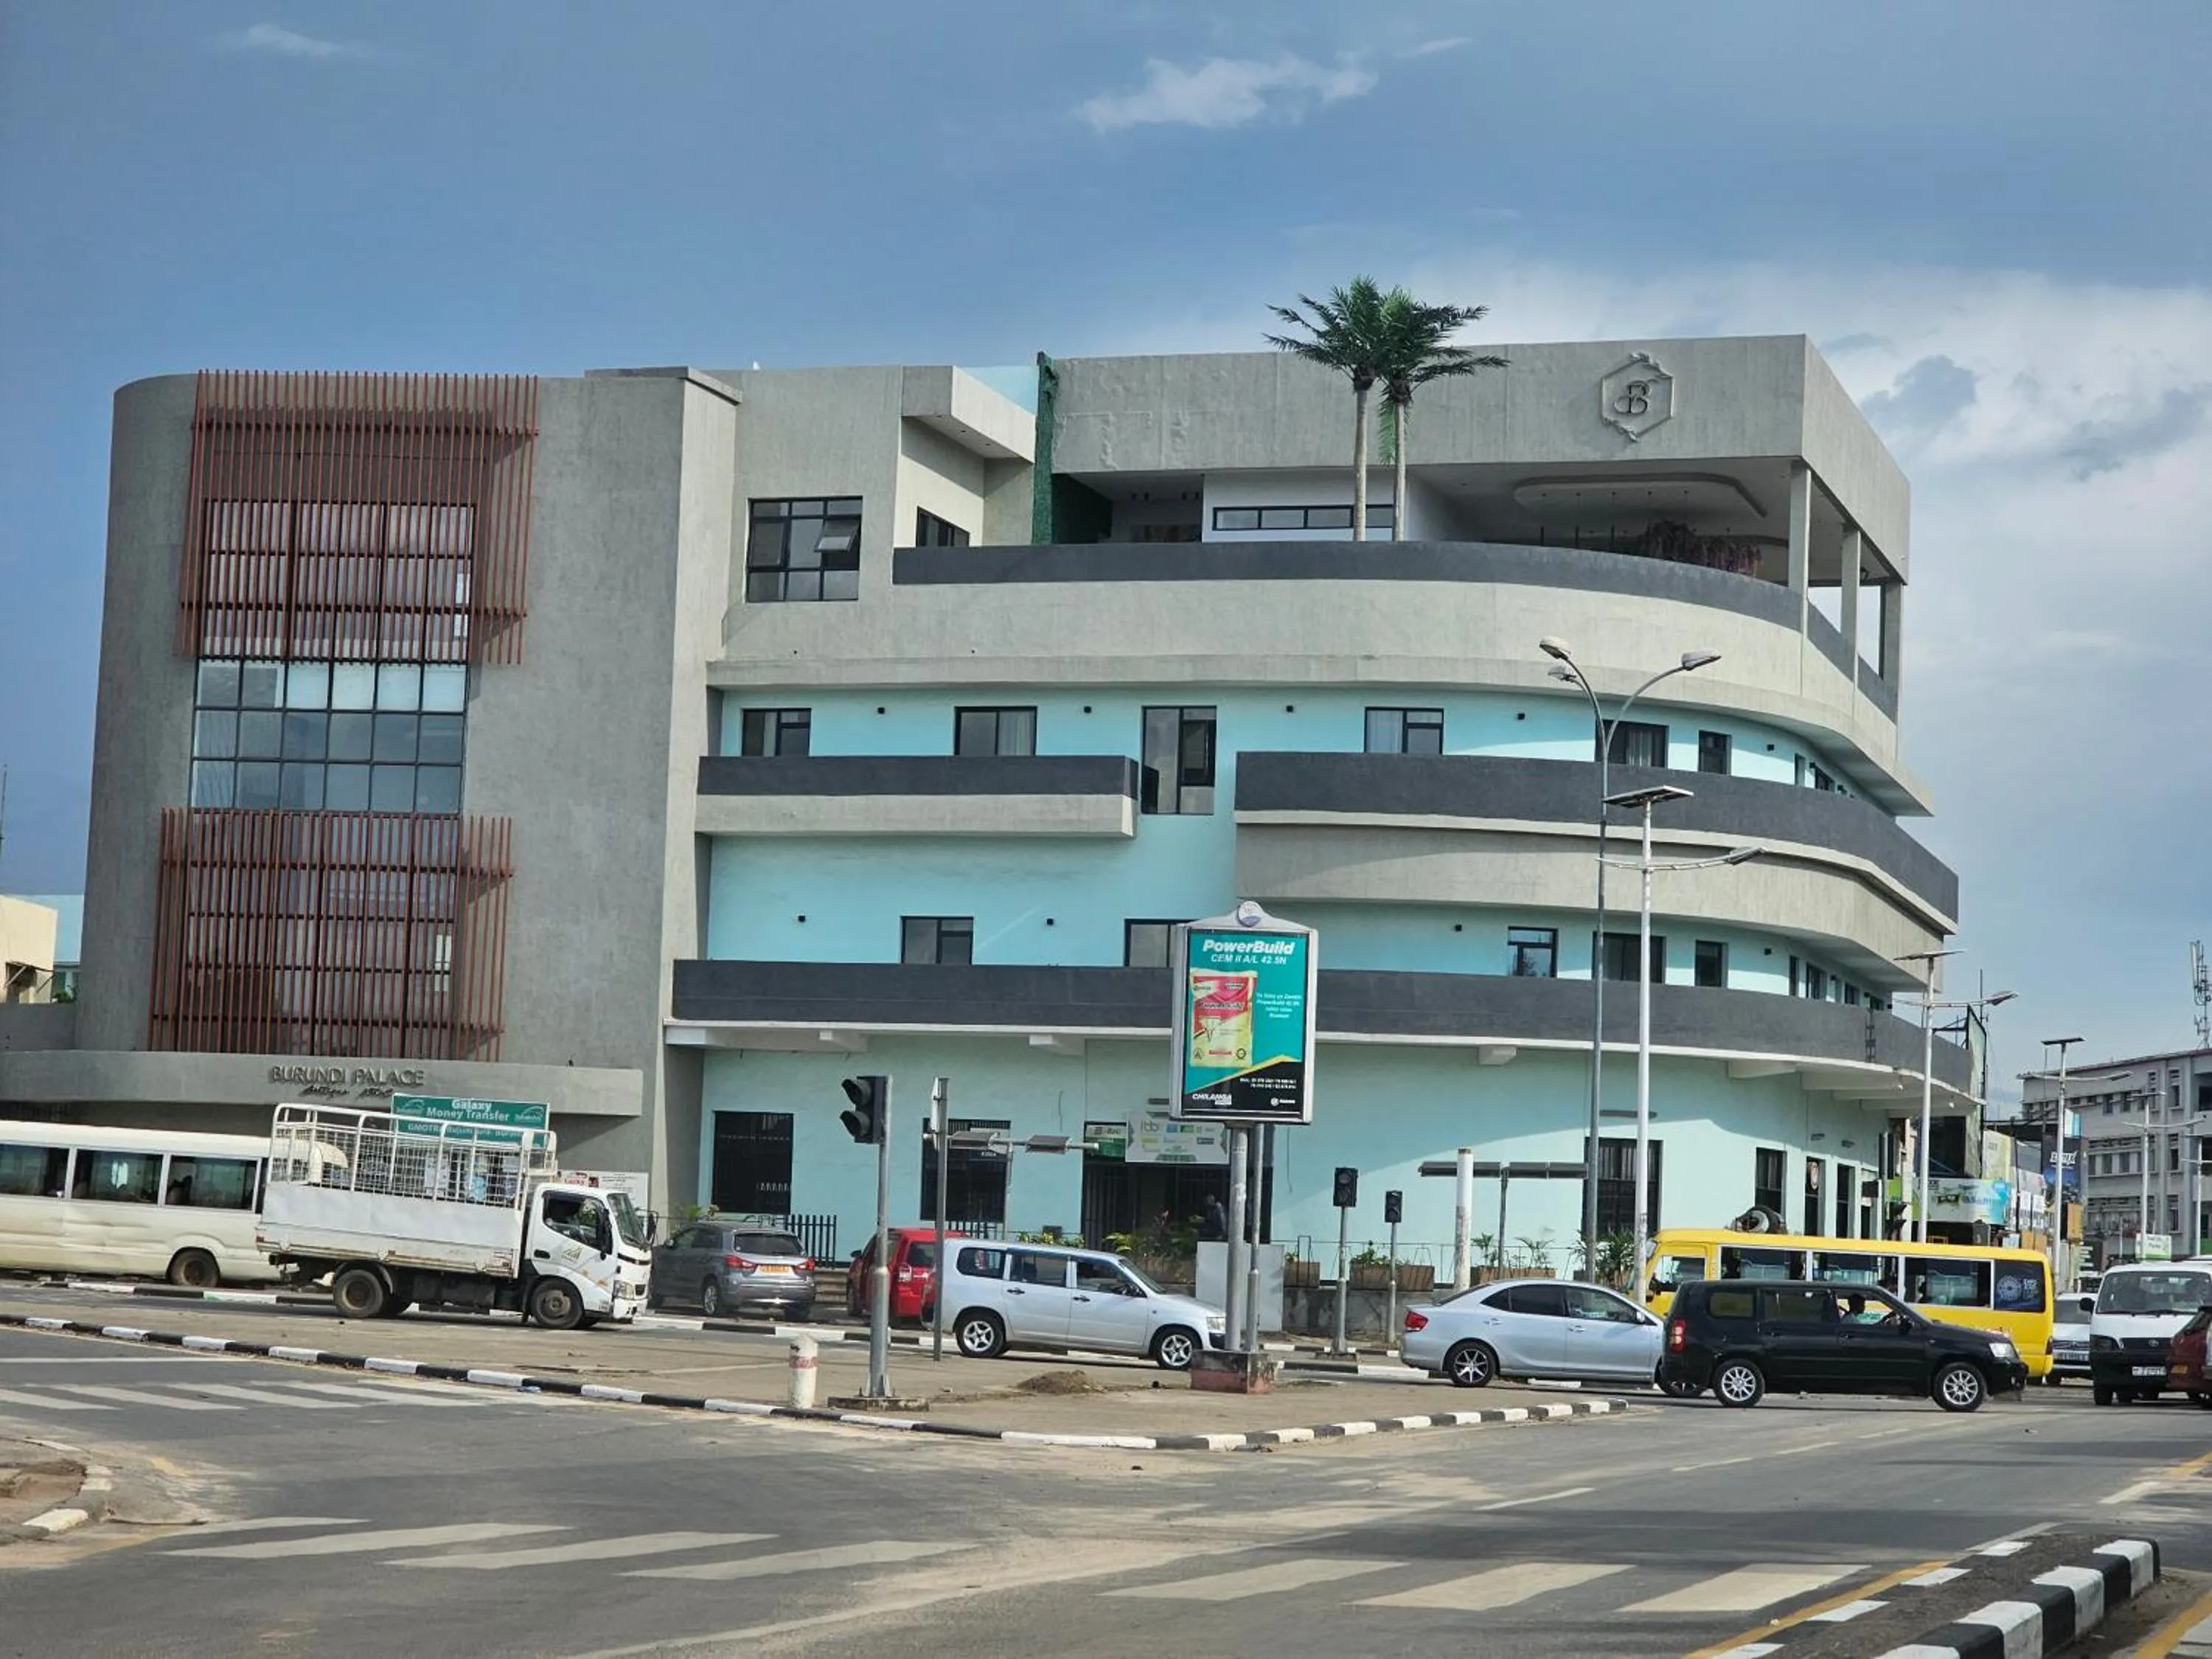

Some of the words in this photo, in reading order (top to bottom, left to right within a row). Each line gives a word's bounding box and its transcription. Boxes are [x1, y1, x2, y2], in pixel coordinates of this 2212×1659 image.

[1202, 939, 1295, 955] PowerBuild
[272, 1065, 346, 1083] BURUNDI
[352, 1068, 425, 1086] PALACE
[451, 1099, 492, 1112] Galaxy
[426, 1107, 464, 1119] Money
[466, 1109, 510, 1121] Transfer
